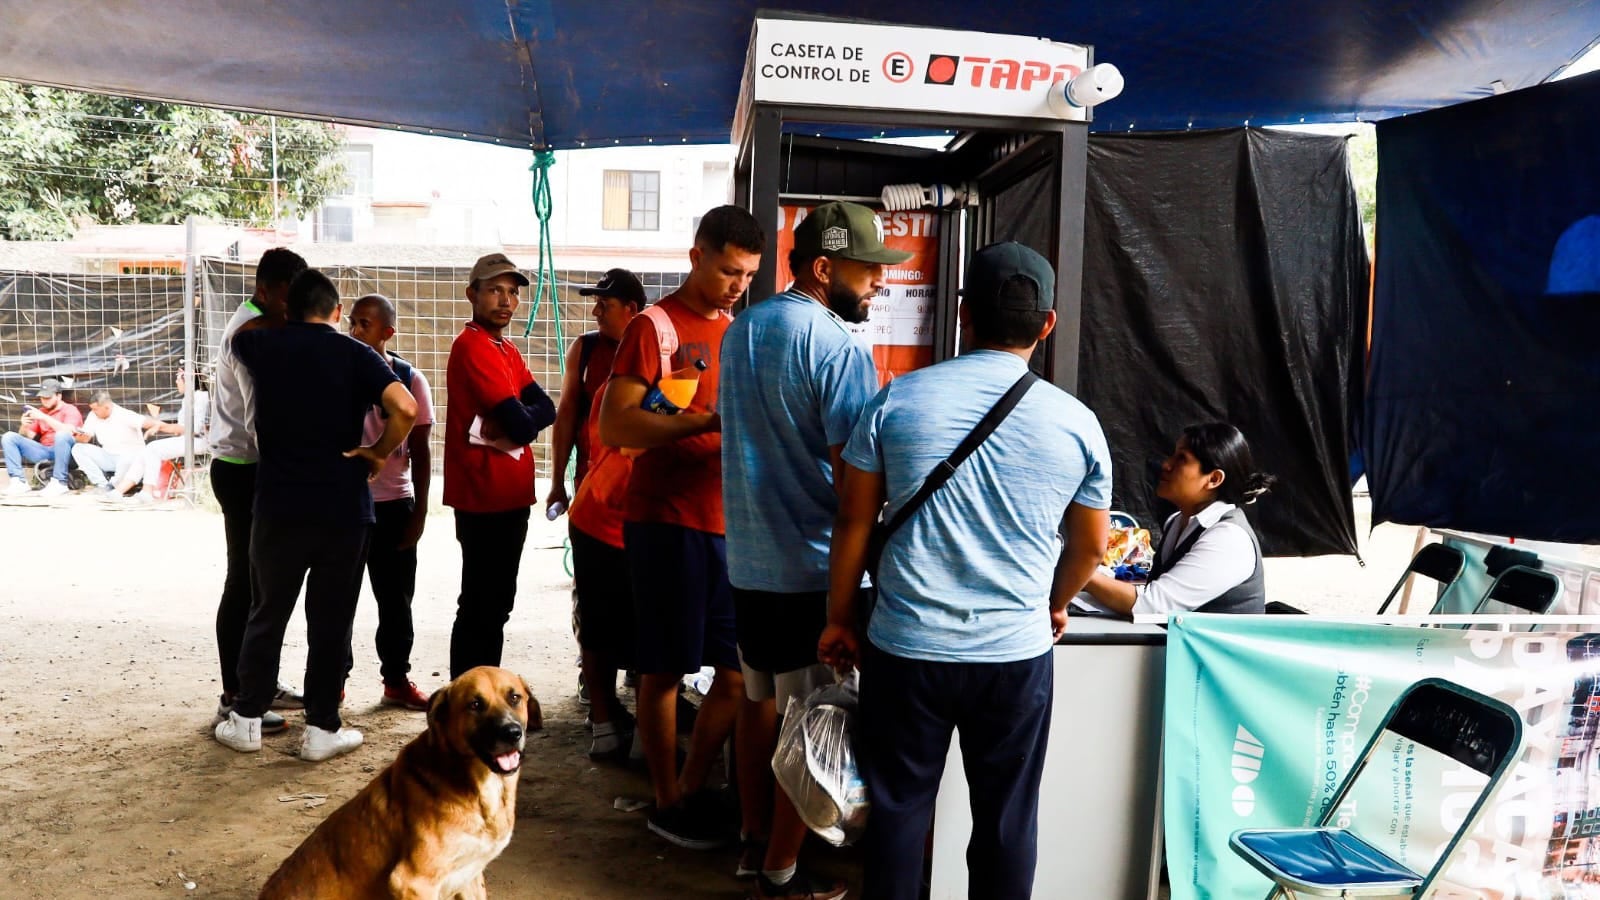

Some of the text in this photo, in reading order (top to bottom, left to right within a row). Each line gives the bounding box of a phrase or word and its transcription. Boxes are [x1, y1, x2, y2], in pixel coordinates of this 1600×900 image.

[771, 43, 864, 61] CASETA DE
[761, 64, 870, 83] CONTROL DE
[891, 58, 905, 76] E
[880, 211, 938, 238] ESTI
[883, 269, 924, 280] OMINGO:
[905, 288, 938, 298] HORA
[1325, 712, 1341, 755] hasta
[1393, 737, 1404, 764] viajar
[1406, 743, 1415, 755] es
[1405, 757, 1415, 768] la
[1324, 760, 1337, 793] 50%
[1404, 770, 1415, 800] señal
[1393, 776, 1402, 815] ahorrar
[1404, 802, 1412, 820] que
[1390, 817, 1399, 835] con
